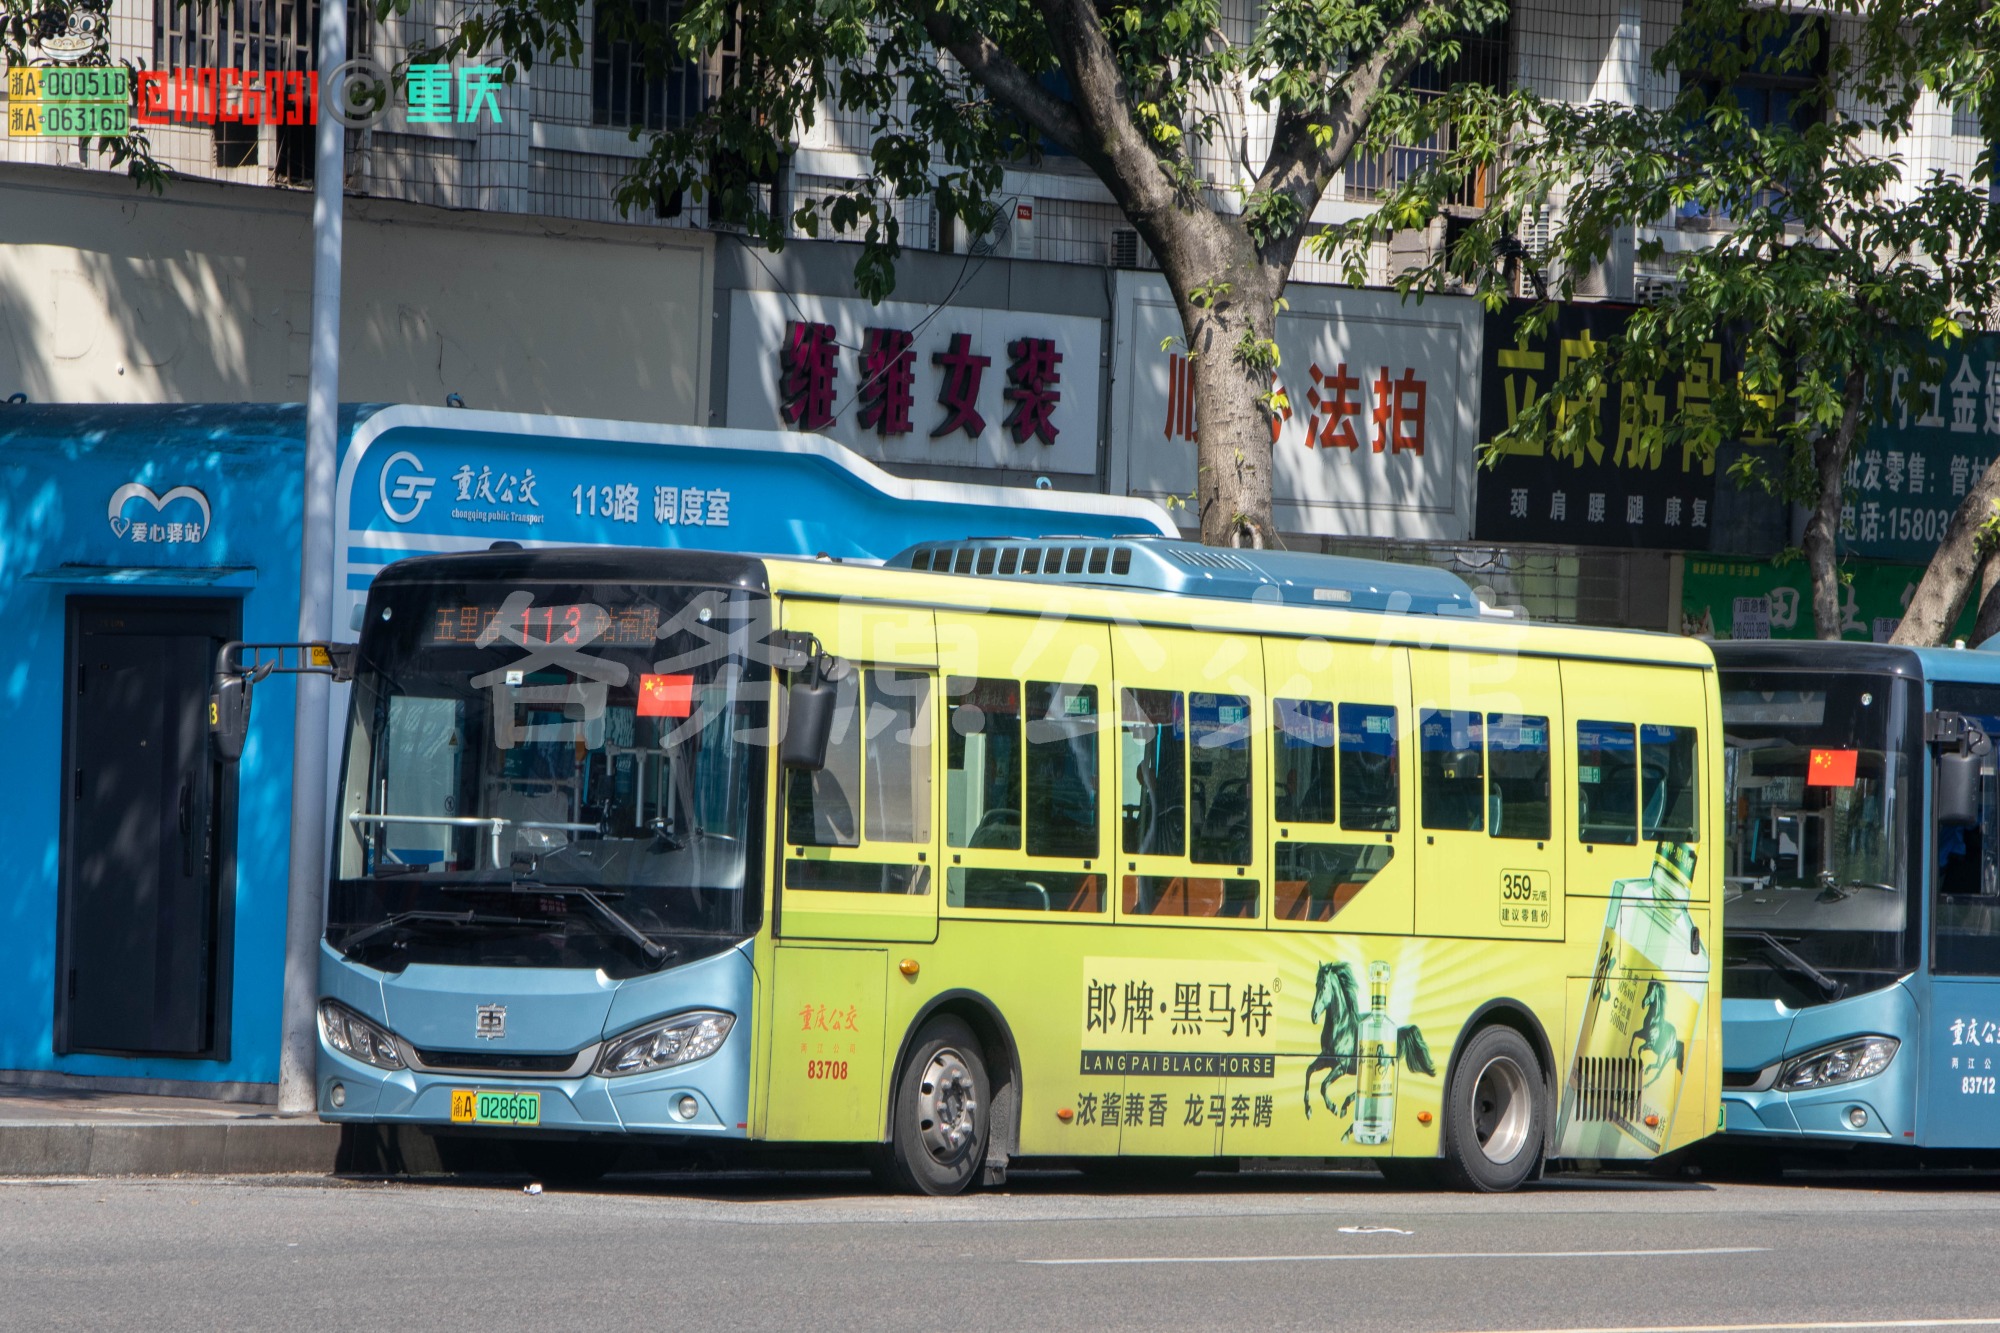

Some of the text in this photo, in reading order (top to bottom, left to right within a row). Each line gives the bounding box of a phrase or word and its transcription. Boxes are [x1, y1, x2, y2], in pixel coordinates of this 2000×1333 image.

[1019, 208, 1031, 217] TCL
[781, 321, 1063, 446] 维维女装
[451, 463, 540, 507] 重庆公交
[451, 508, 544, 526] chongqing public Transport
[572, 482, 730, 527] 113路 调度室
[131, 522, 201, 544] 爱心驿站
[433, 606, 503, 643] 五里店
[521, 606, 581, 645] 113
[1501, 907, 1549, 923] 建议零售价
[798, 1003, 859, 1033] 重庆公交
[807, 1059, 848, 1080] 83708
[1961, 1076, 1996, 1095] 83712
[1075, 1091, 1273, 1129] 浓酱兼香 龙马奔腾
